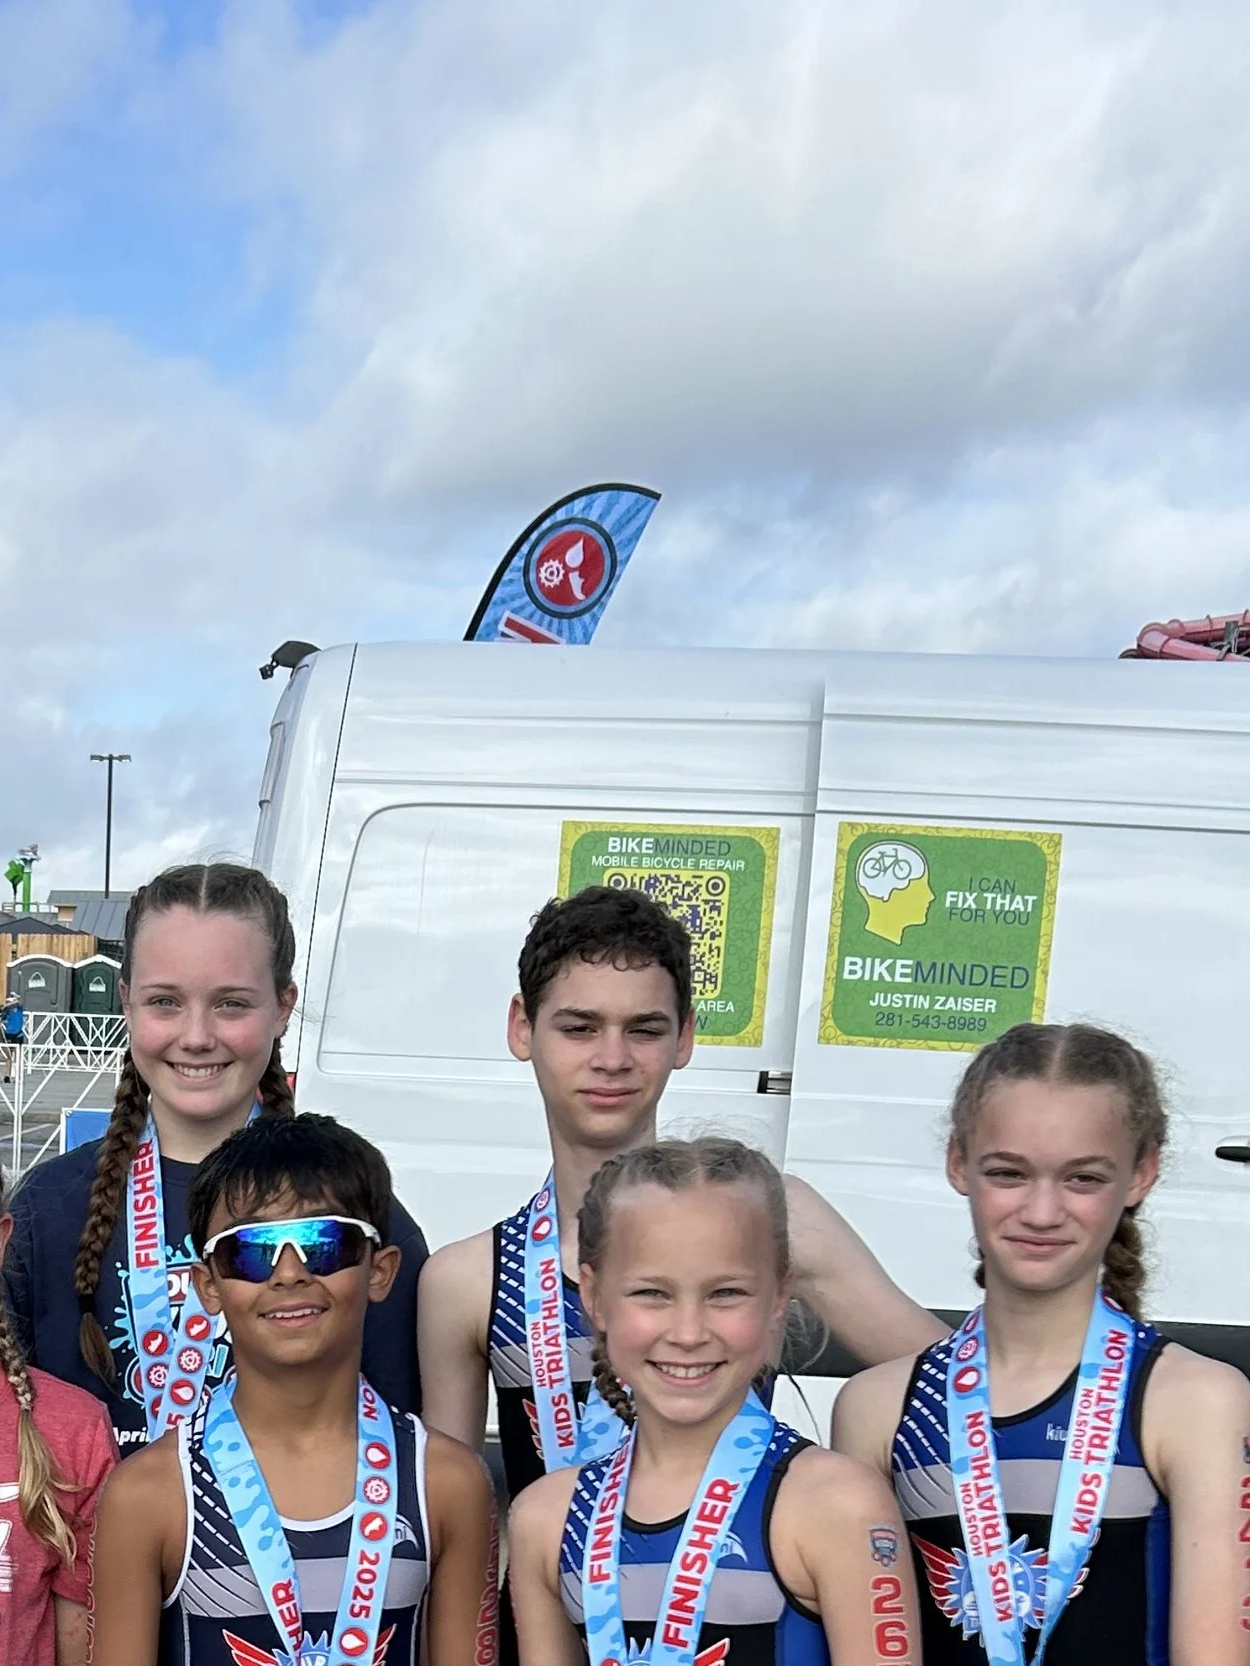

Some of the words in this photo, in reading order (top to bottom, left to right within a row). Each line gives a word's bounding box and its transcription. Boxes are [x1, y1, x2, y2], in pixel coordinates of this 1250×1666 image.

[592, 856, 639, 868] MOBILE
[642, 858, 695, 870] BICYCLE
[699, 860, 745, 871] REPAIR
[607, 837, 731, 857] BIKEMINDED
[945, 891, 978, 908] FIX
[984, 893, 1037, 912] THAT
[949, 908, 985, 923] FOR
[993, 909, 1030, 926] YOU
[978, 878, 1016, 893] CAN
[842, 956, 1030, 989] BIKEMINDED
[869, 993, 930, 1009] JUSTIN
[933, 996, 997, 1013] ZAISER
[697, 1001, 734, 1013] AREA
[875, 1012, 987, 1032] 281-543-8989
[134, 1138, 159, 1269] FINISHER
[529, 1321, 548, 1388] HOUSTON
[539, 1258, 565, 1390] TRIATHLON
[551, 1392, 574, 1448] KIDS
[1069, 1388, 1095, 1461] HOUSTON
[1083, 1329, 1129, 1466] TRIATHLON
[588, 1440, 630, 1585] FINISHE
[965, 1410, 1003, 1558] TRIATHLON
[1069, 1472, 1103, 1535] KIDS
[960, 1483, 985, 1557] HOUSTON
[348, 1550, 381, 1620] 2025
[661, 1476, 740, 1649] FINISHER
[988, 1560, 1014, 1623] KIDS
